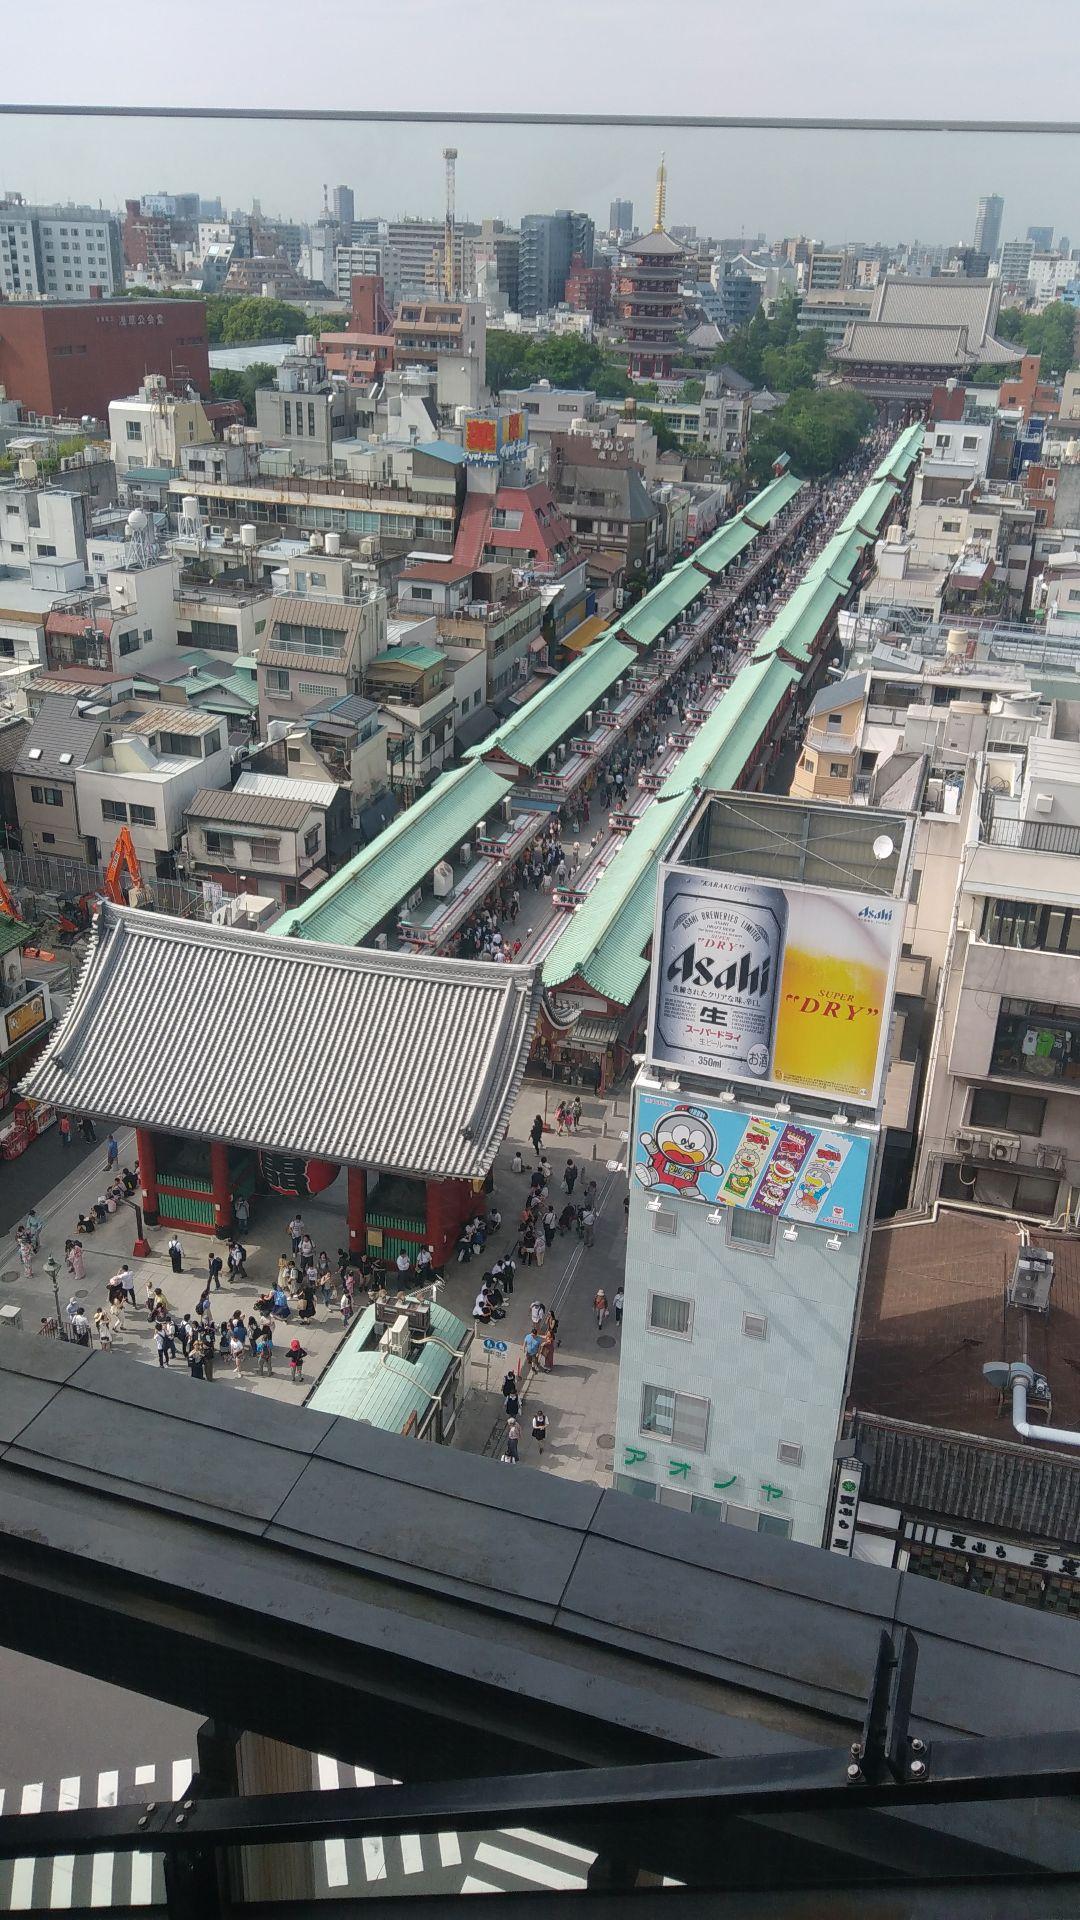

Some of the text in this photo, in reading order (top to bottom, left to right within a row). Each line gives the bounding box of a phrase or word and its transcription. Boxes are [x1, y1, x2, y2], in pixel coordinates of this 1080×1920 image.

[858, 906, 893, 922] Asahi
[682, 914, 700, 930] ASAHI
[701, 910, 739, 924] BREWERIES
[740, 921, 762, 942] LIMITED
[667, 943, 771, 998] Asahi
[818, 989, 855, 1002] SUPER
[700, 1007, 728, 1027] 生
[685, 1025, 741, 1042] スーパードライ
[698, 1056, 722, 1069] 350ml
[624, 1447, 783, 1502] アオノヤ
